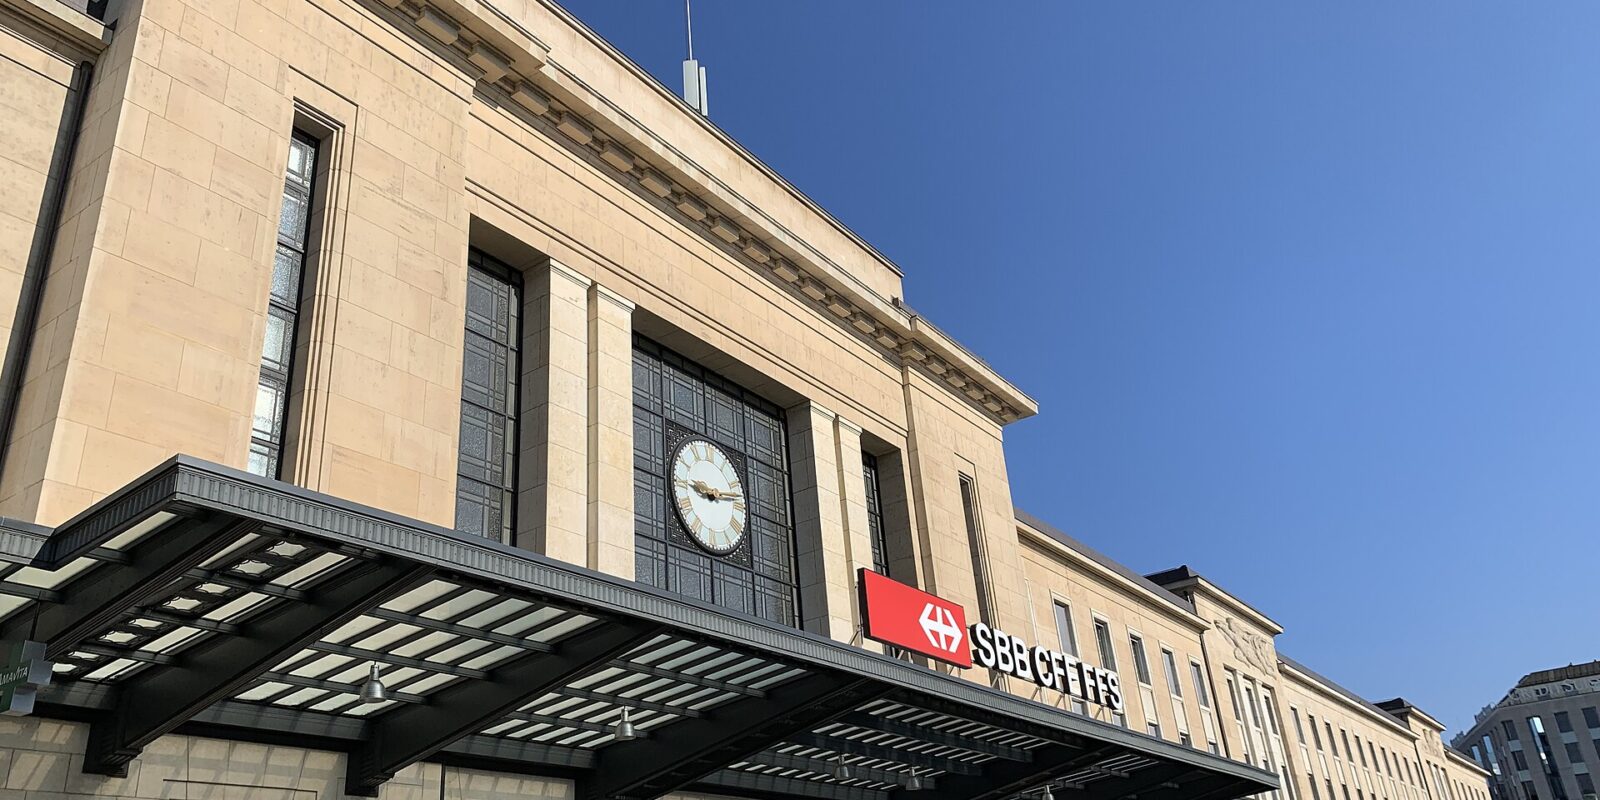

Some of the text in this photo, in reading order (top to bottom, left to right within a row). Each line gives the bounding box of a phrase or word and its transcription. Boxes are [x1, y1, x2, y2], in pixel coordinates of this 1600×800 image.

[974, 622, 1124, 711] SBB CFF FFS
